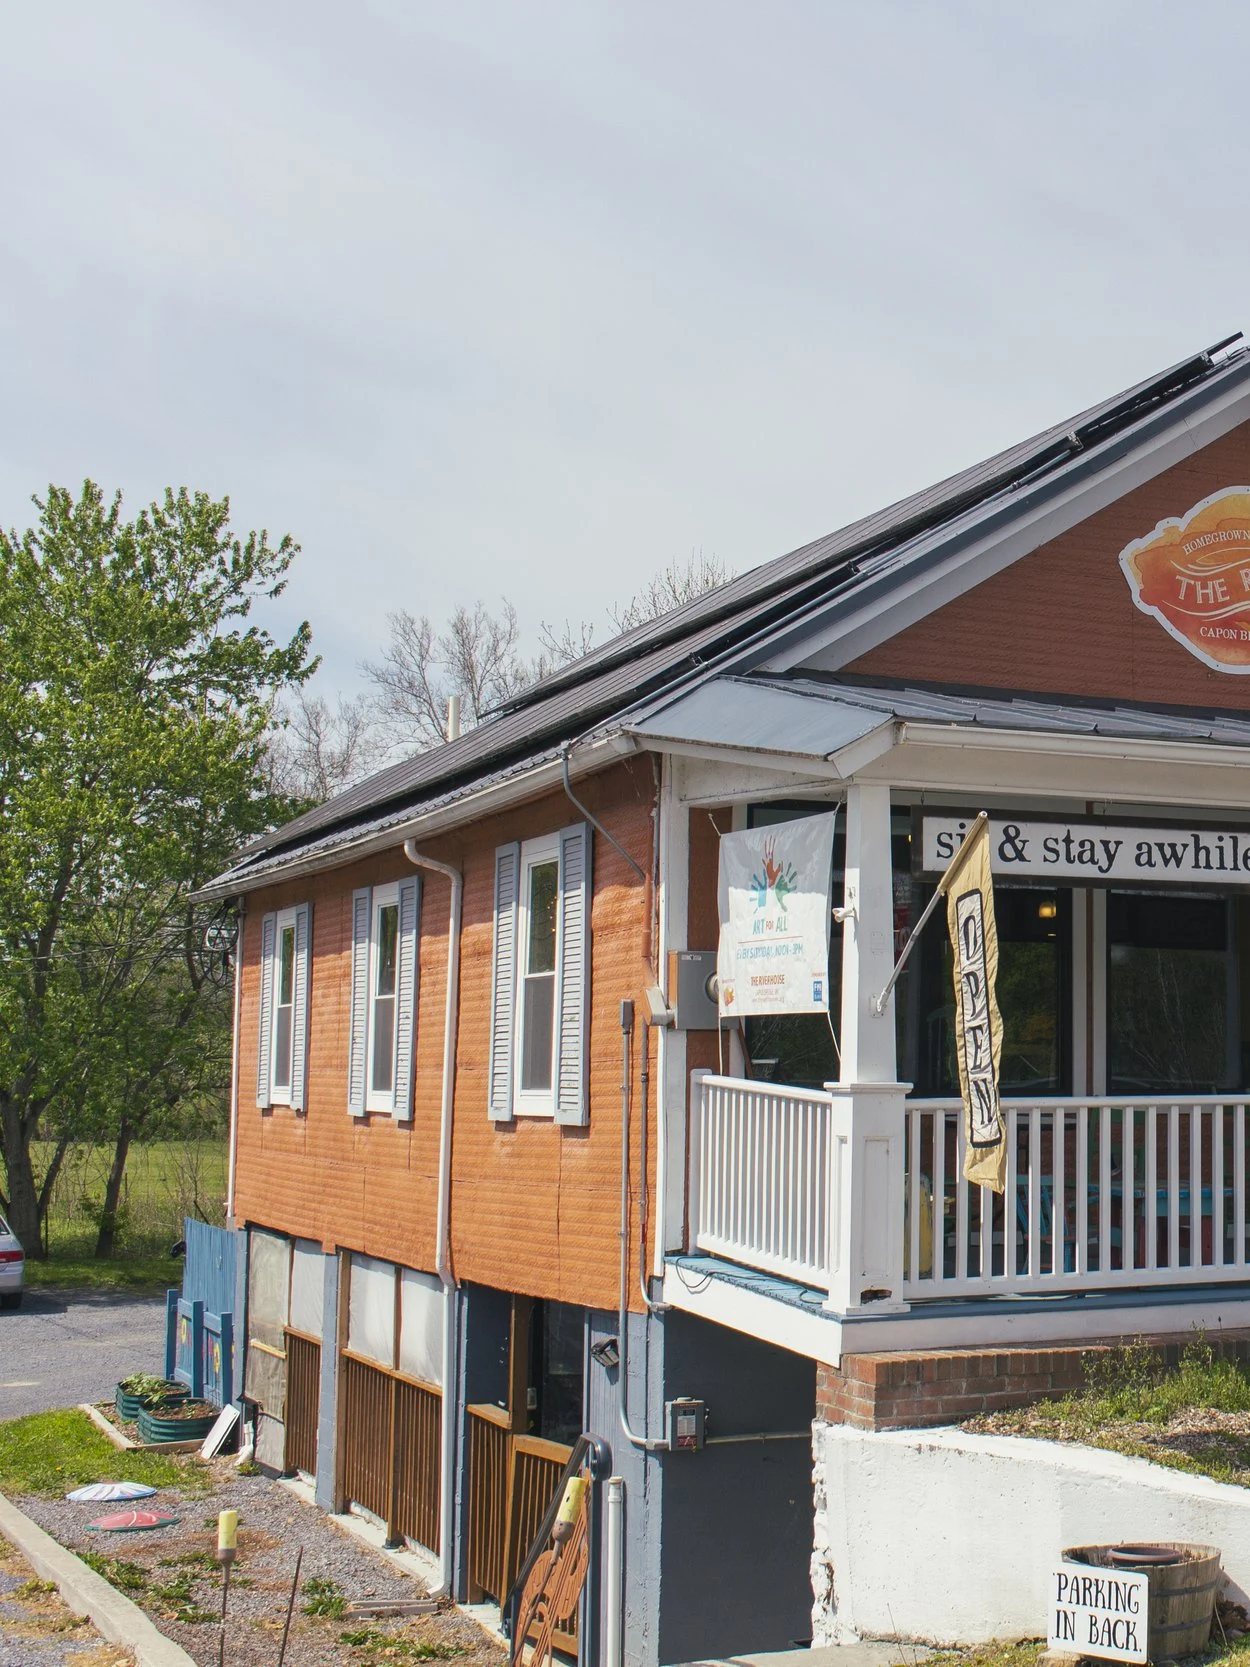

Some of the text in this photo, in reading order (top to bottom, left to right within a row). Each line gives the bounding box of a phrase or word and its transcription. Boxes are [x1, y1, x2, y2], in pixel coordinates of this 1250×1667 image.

[1182, 529, 1250, 556] HOMEGROWN
[1175, 575, 1230, 604] THE
[1200, 626, 1238, 640] CAPON
[936, 822, 967, 859] si
[998, 823, 1032, 864] &
[1042, 828, 1124, 874] stay
[752, 918, 766, 935] ART
[776, 916, 788, 932] ALL
[962, 914, 994, 1126] OPEN
[1056, 1572, 1140, 1615] PARKING
[1055, 1609, 1138, 1652] IN BACK
